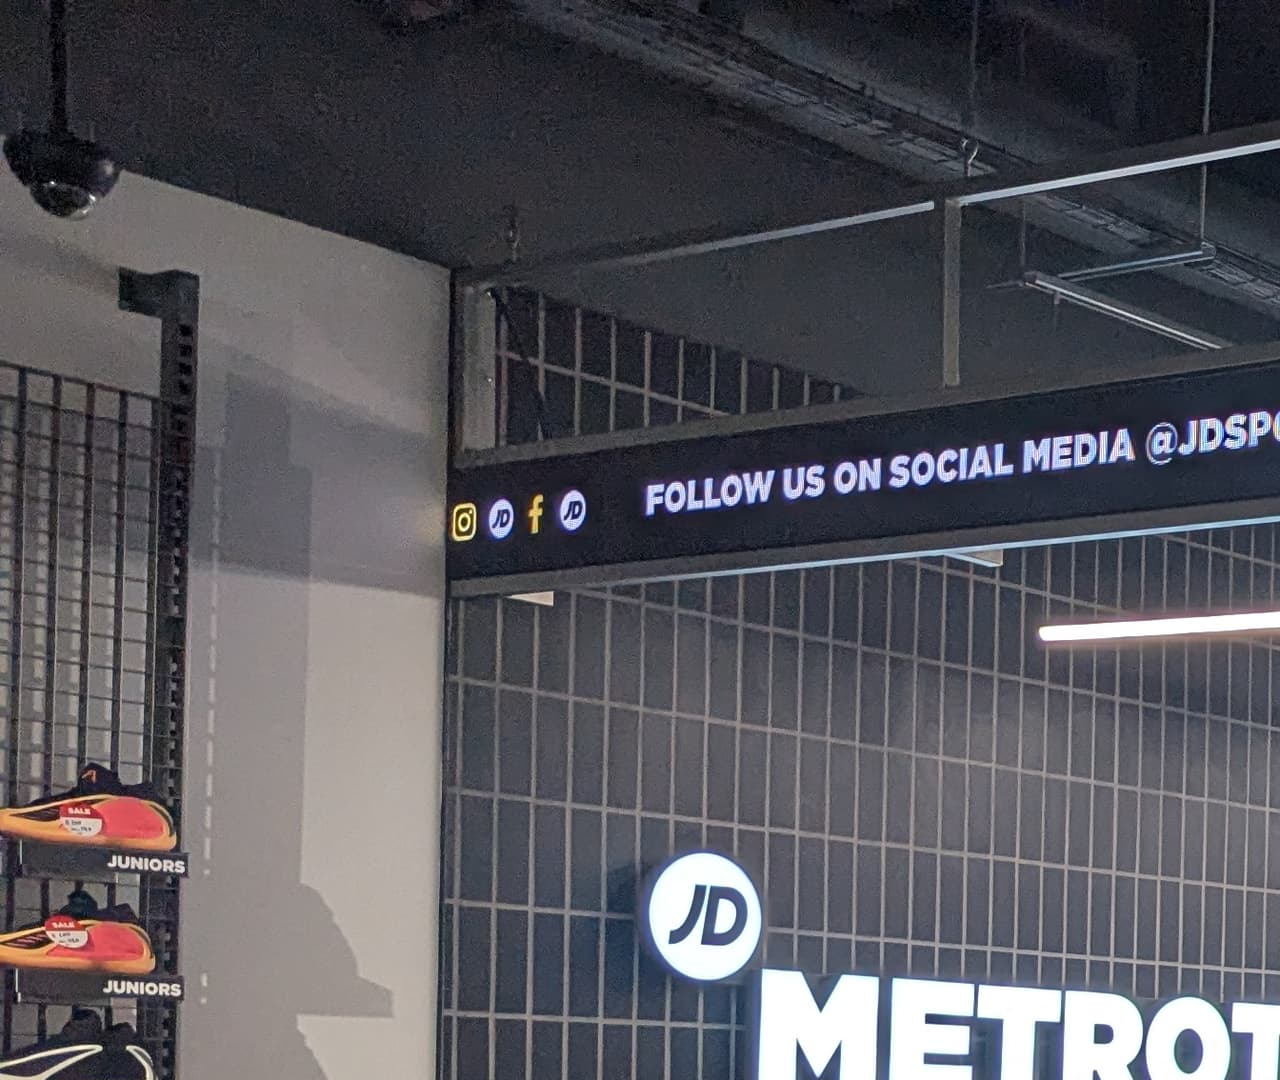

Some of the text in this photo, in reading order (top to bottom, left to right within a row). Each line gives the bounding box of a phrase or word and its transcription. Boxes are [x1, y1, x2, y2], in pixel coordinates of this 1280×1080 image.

[646, 470, 775, 515] FOLLOW
[783, 464, 824, 499] US
[833, 459, 882, 494] ON
[889, 444, 1014, 487] SOCIAL
[1023, 428, 1135, 473] MEDIA
[107, 855, 186, 873] JUNIORS
[669, 884, 748, 946] JD
[103, 980, 182, 996] JUNIORS
